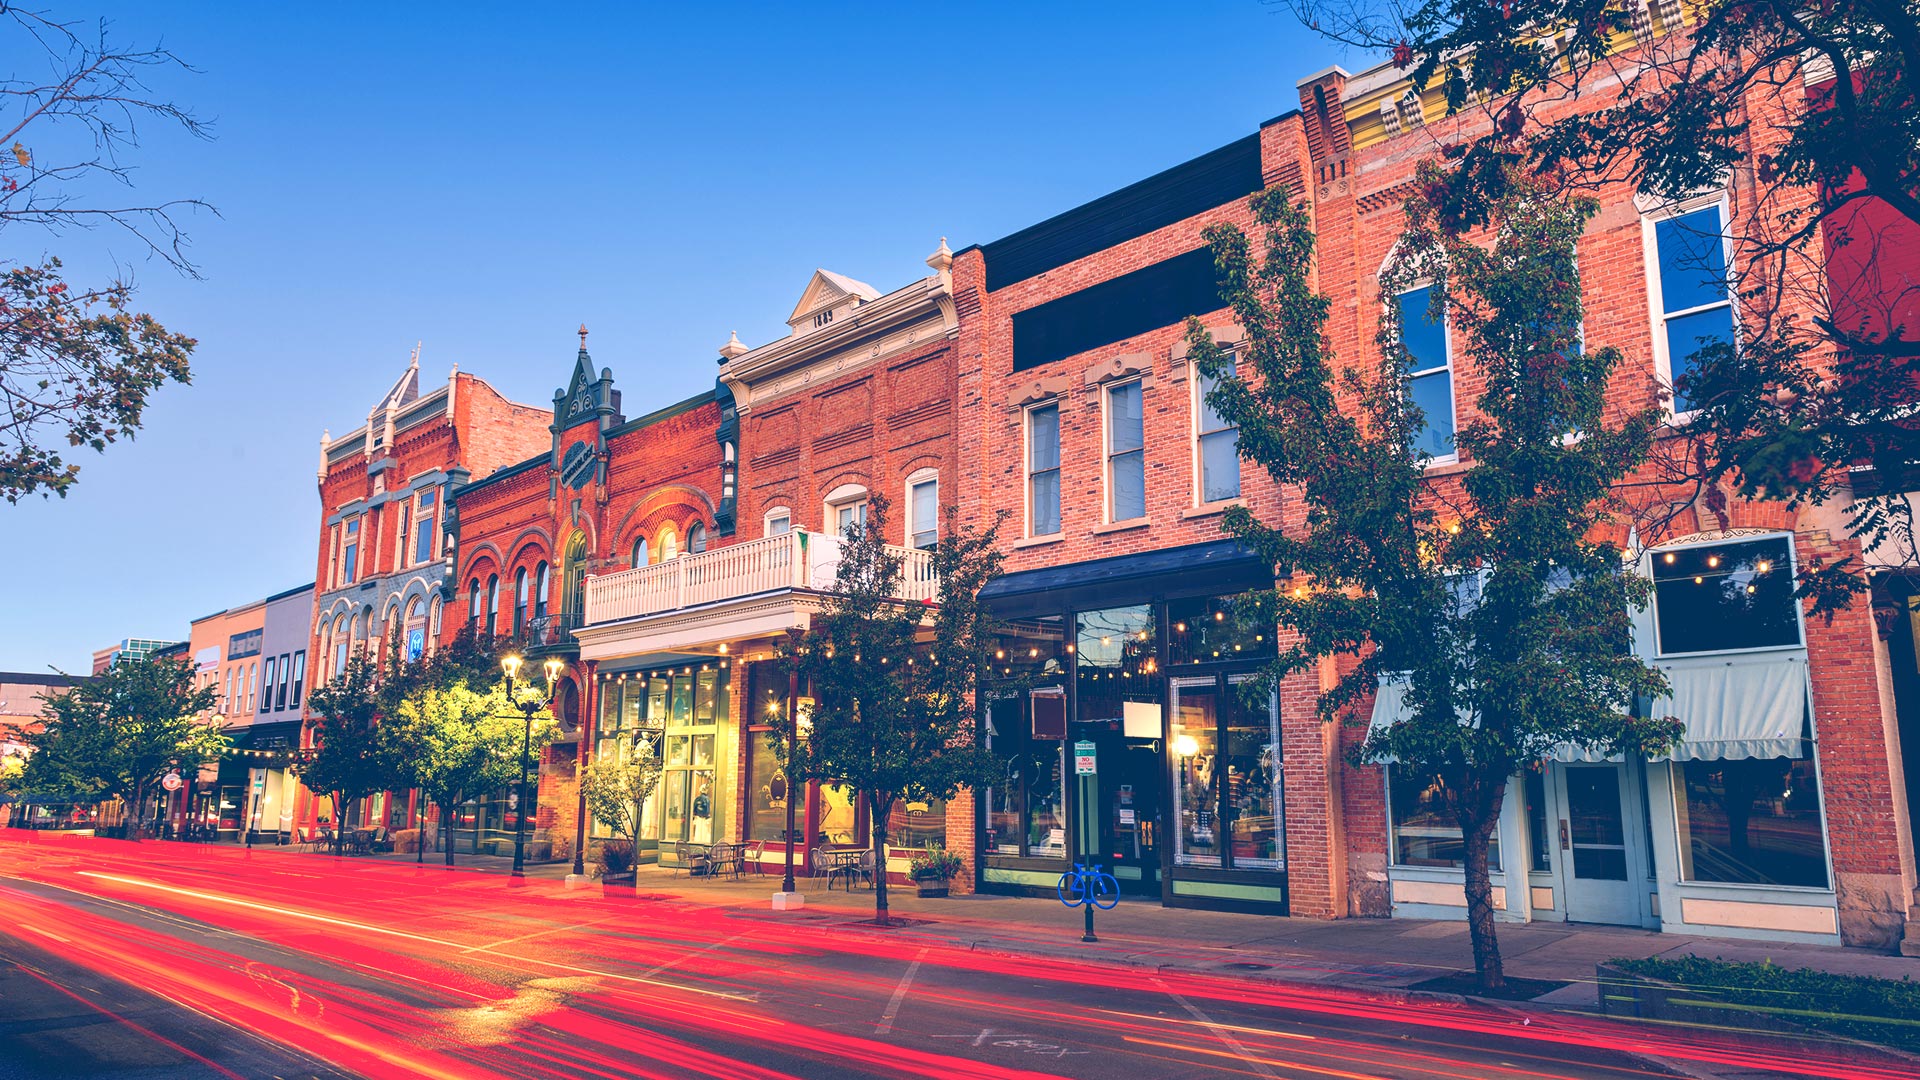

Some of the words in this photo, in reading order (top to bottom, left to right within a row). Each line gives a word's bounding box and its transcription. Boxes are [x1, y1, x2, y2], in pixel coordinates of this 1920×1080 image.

[814, 310, 833, 328] 1889
[561, 463, 577, 484] UNION
[576, 445, 593, 469] BLOCK
